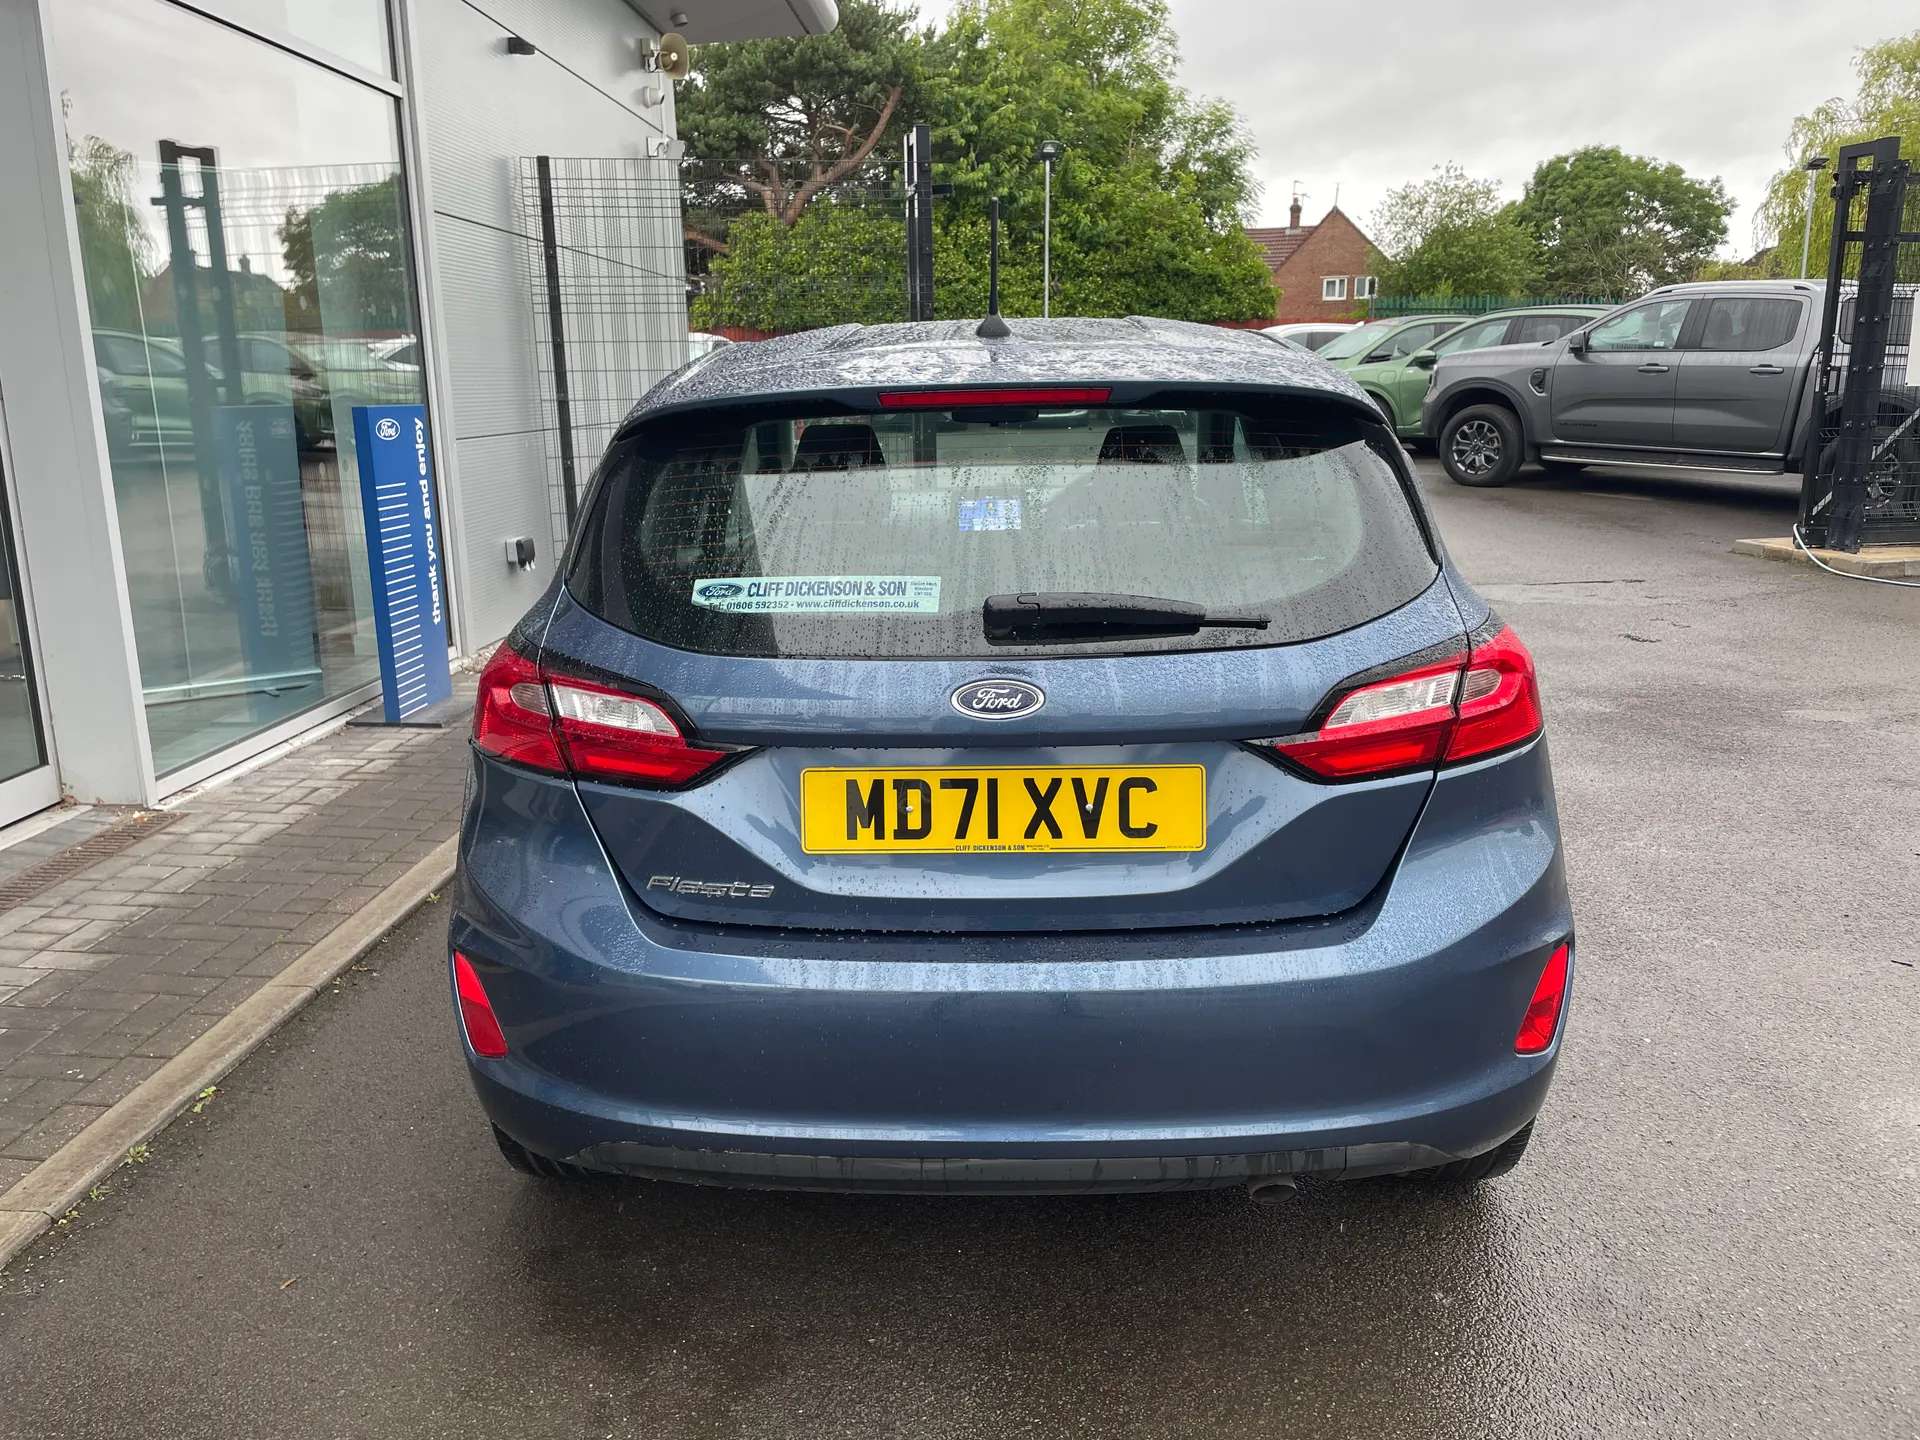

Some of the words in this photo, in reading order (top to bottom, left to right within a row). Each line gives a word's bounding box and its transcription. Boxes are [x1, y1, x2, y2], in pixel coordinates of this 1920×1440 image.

[414, 417, 427, 476] enjoy
[419, 479, 431, 520] and
[425, 523, 437, 562] you
[428, 563, 441, 625] thank
[726, 601, 753, 610] 01606
[755, 600, 789, 609] 592352
[797, 599, 920, 609] www.cliffdickenson.co.uk
[747, 582, 784, 598] CLIFF
[785, 581, 862, 597] DICKENSON
[864, 581, 876, 596] &
[878, 581, 907, 597] SON
[972, 688, 1022, 709] Ford
[845, 777, 999, 842] MD71
[1023, 776, 1159, 840] XVC
